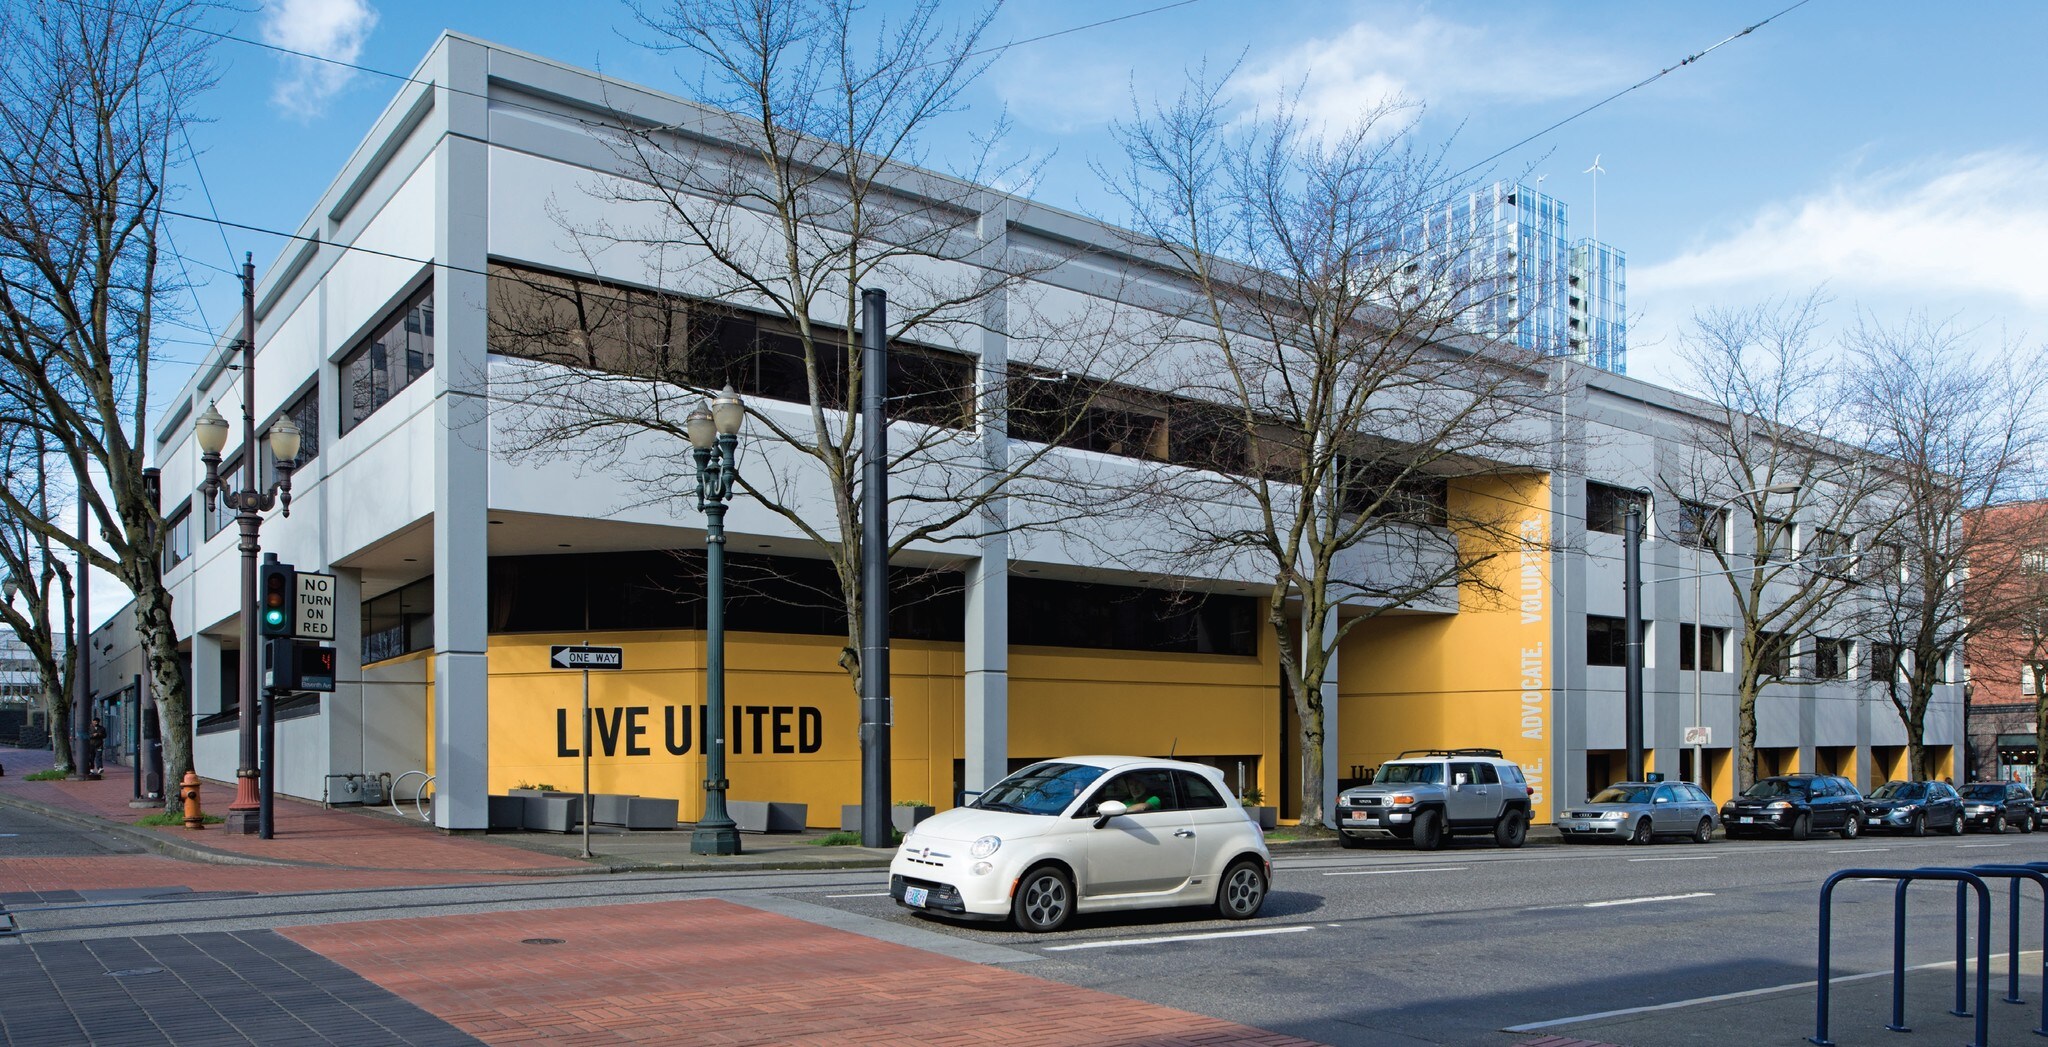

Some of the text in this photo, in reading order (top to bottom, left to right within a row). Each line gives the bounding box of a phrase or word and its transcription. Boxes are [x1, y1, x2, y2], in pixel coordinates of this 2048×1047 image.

[305, 579, 327, 591] NO
[300, 594, 331, 606] TURN
[307, 608, 323, 619] ON
[303, 622, 328, 633] RED
[322, 653, 330, 670] 4
[569, 653, 617, 662] ONE WAY
[1521, 641, 1543, 740] ADVOCATE.
[664, 705, 822, 755] UITED
